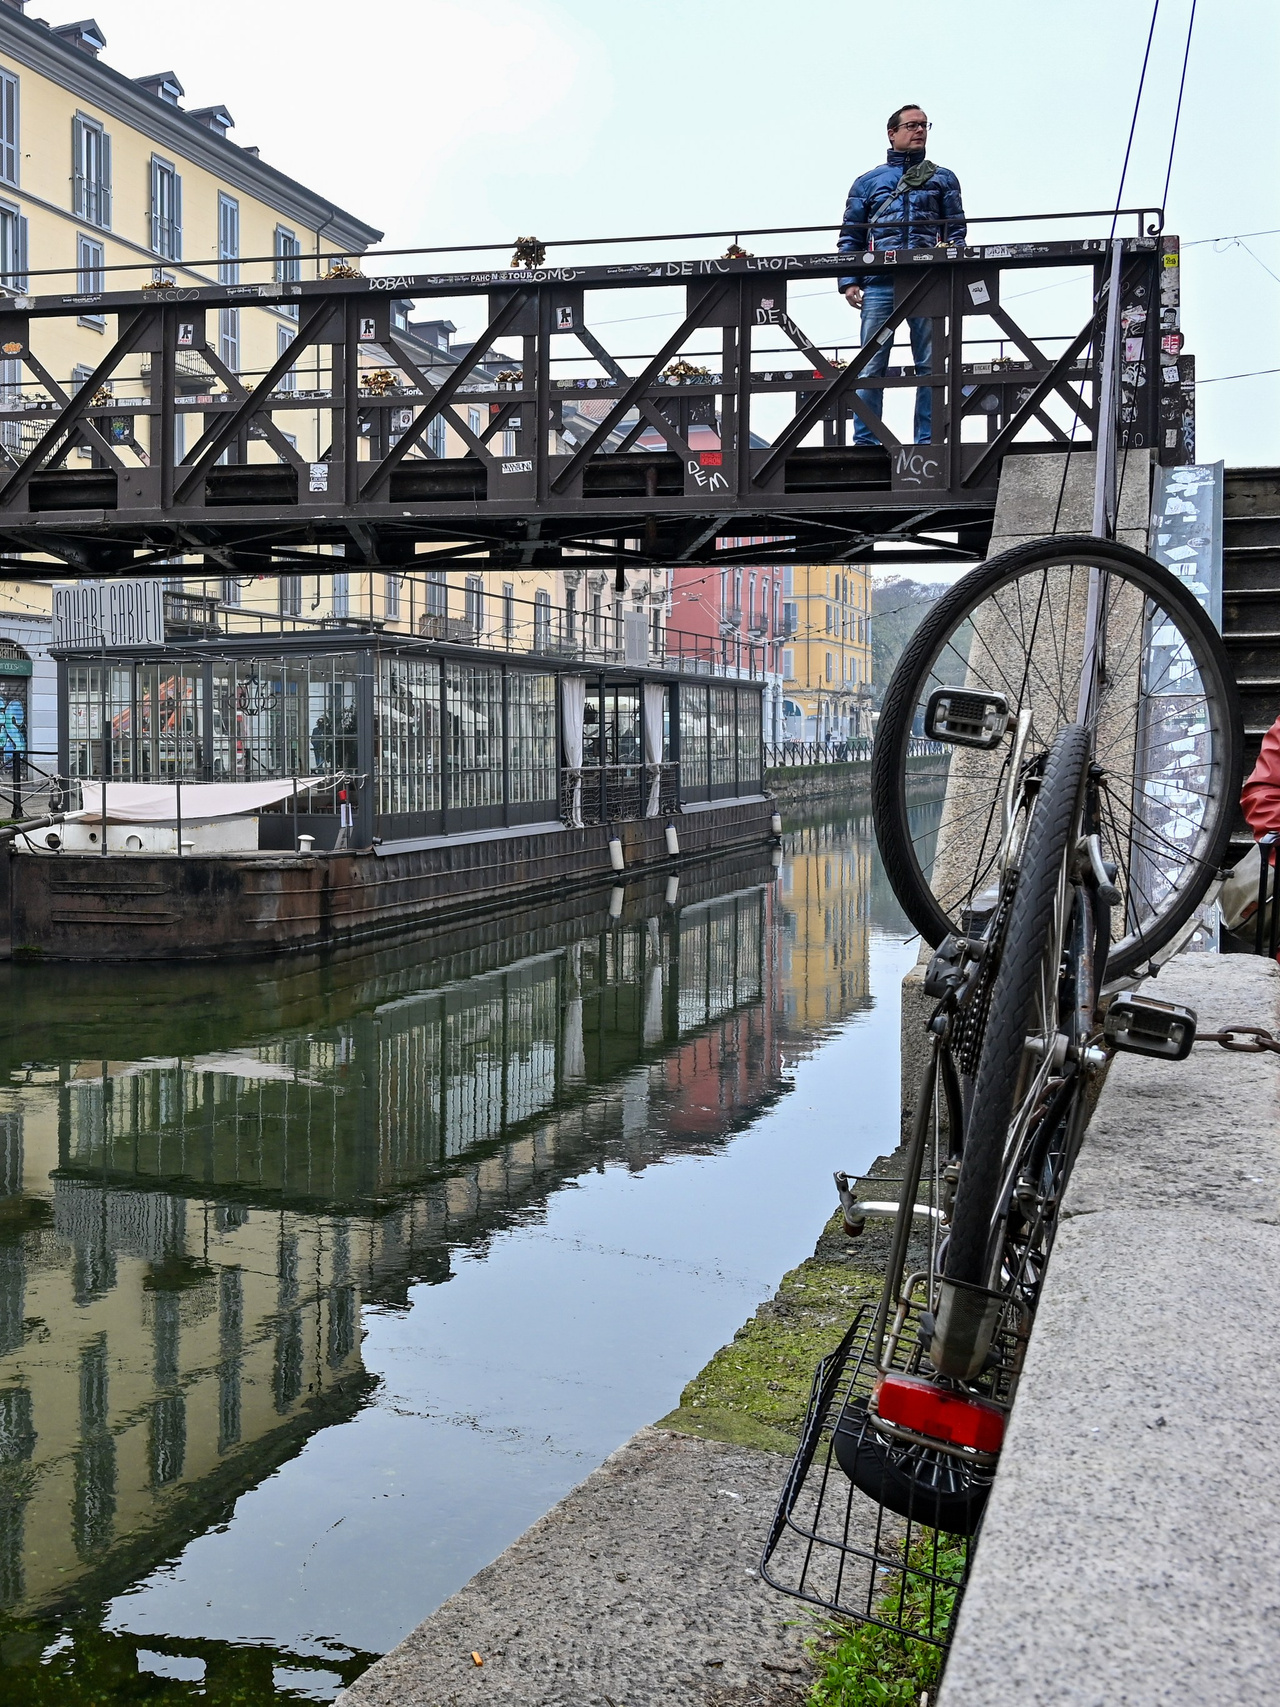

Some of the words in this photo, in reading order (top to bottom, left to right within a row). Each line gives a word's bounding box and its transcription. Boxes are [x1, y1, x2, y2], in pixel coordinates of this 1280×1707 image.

[508, 272, 533, 280] TOUR
[688, 460, 729, 492] DEM
[110, 580, 161, 646] GARDEN
